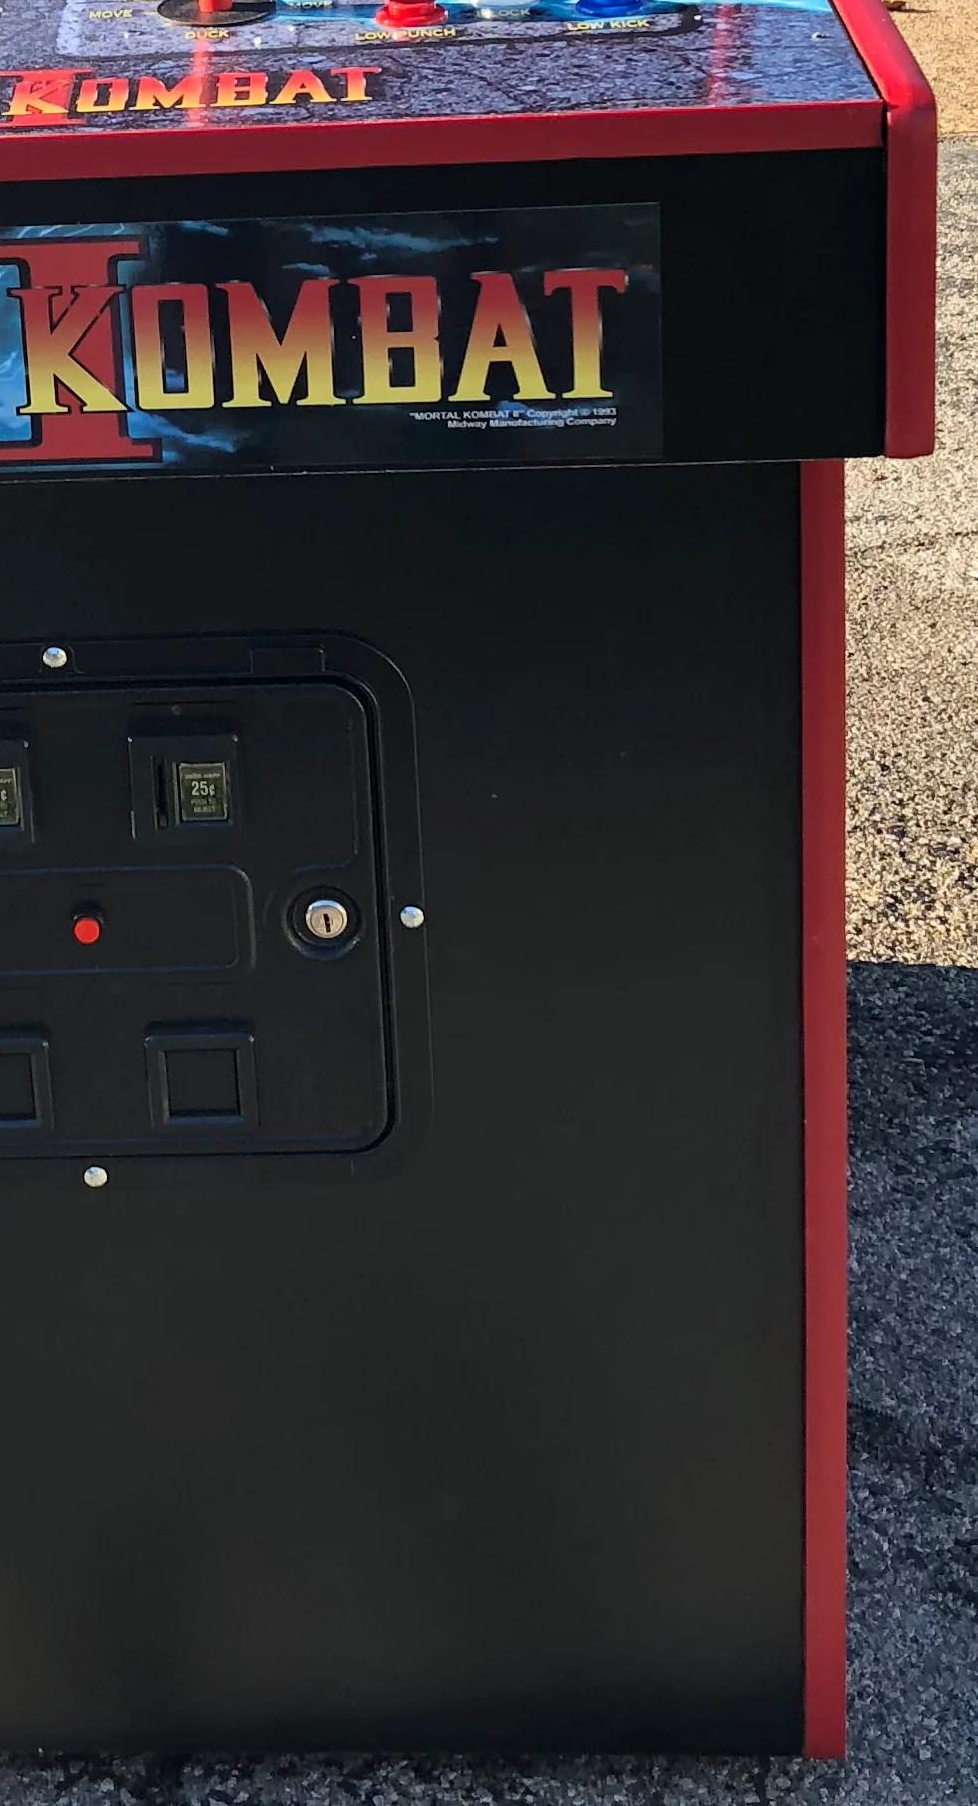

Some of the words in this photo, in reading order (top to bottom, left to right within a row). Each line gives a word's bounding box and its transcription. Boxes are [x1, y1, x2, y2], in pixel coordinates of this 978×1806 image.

[88, 9, 133, 20] MOVE
[566, 21, 609, 31] LOW
[609, 19, 650, 29] KICK
[184, 28, 230, 40] DUCK
[354, 31, 392, 41] LOW
[7, 67, 382, 117] KOMBAT
[7, 267, 628, 415] KOMBAT
[463, 410, 510, 419] KOMBAT
[526, 407, 578, 420] Copyright
[593, 407, 617, 416] 1993
[447, 420, 487, 430] Midway
[489, 418, 565, 429] Manufacturing
[566, 417, 617, 428] Company
[191, 780, 216, 797] 25¢
